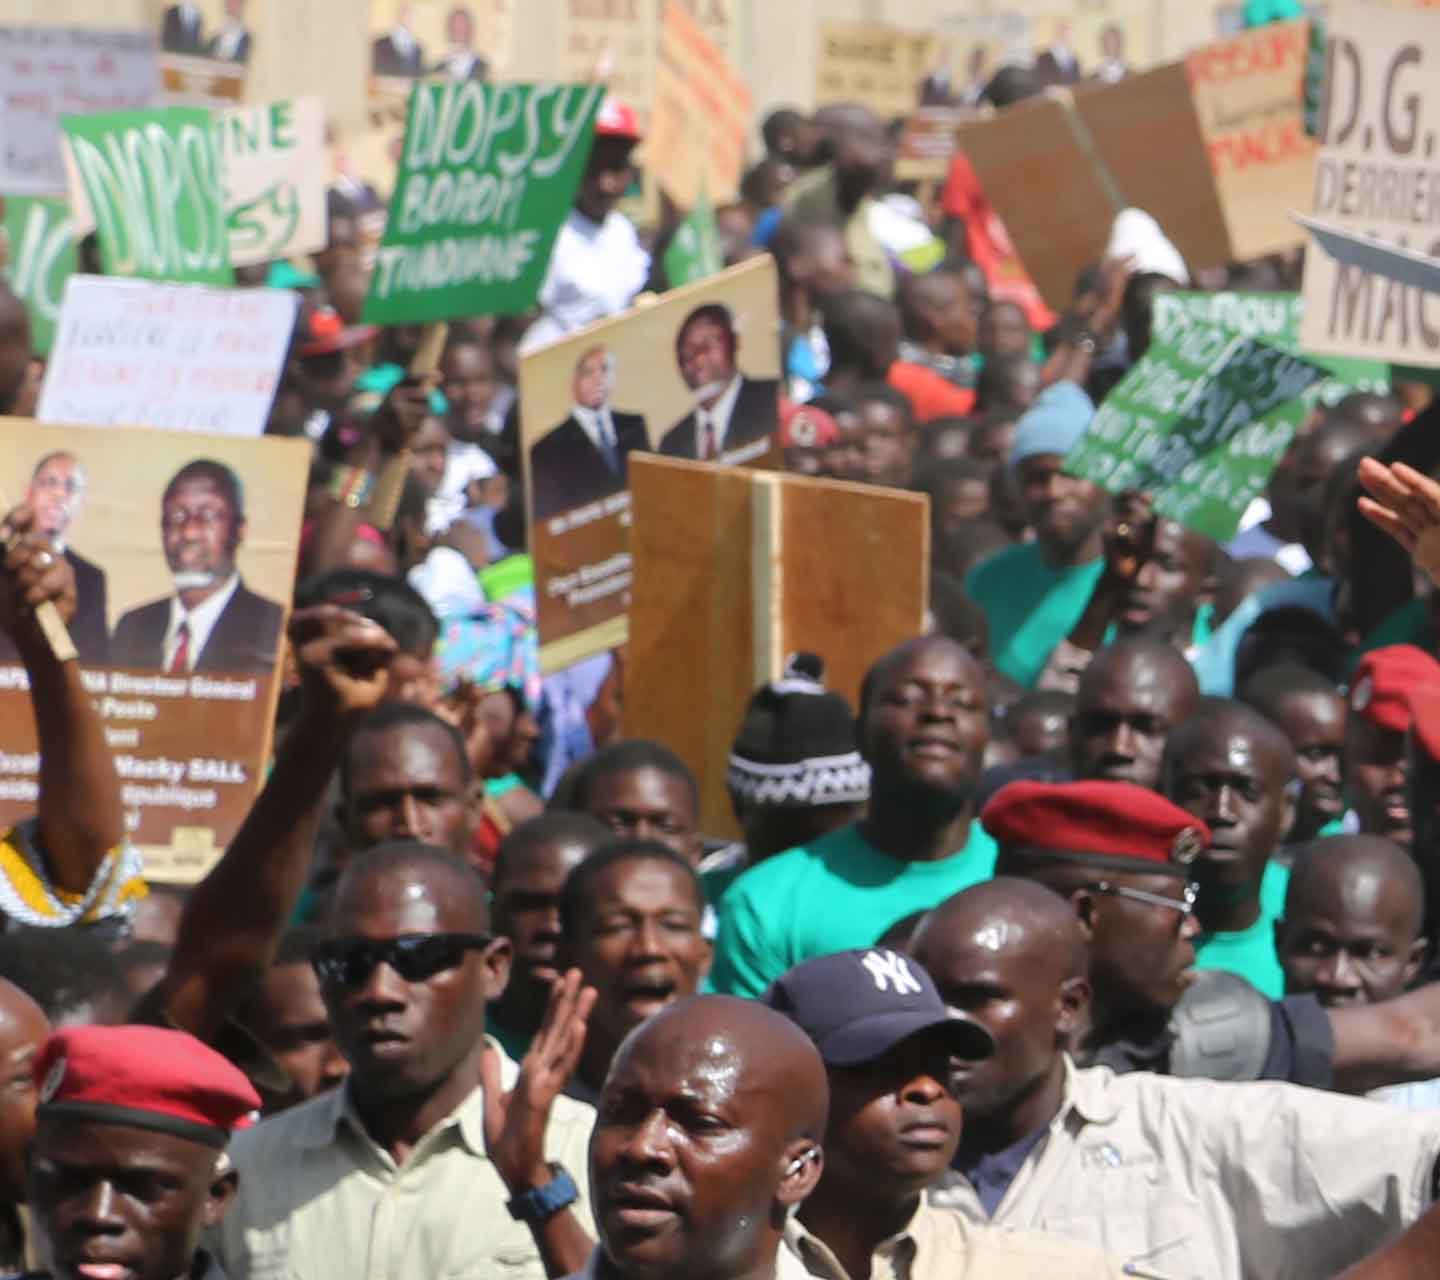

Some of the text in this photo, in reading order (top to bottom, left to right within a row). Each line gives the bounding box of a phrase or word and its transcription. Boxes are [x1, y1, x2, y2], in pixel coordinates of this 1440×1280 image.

[405, 82, 600, 176] NOPSY
[113, 754, 248, 784] Macky SALL
[861, 949, 923, 995] NY
